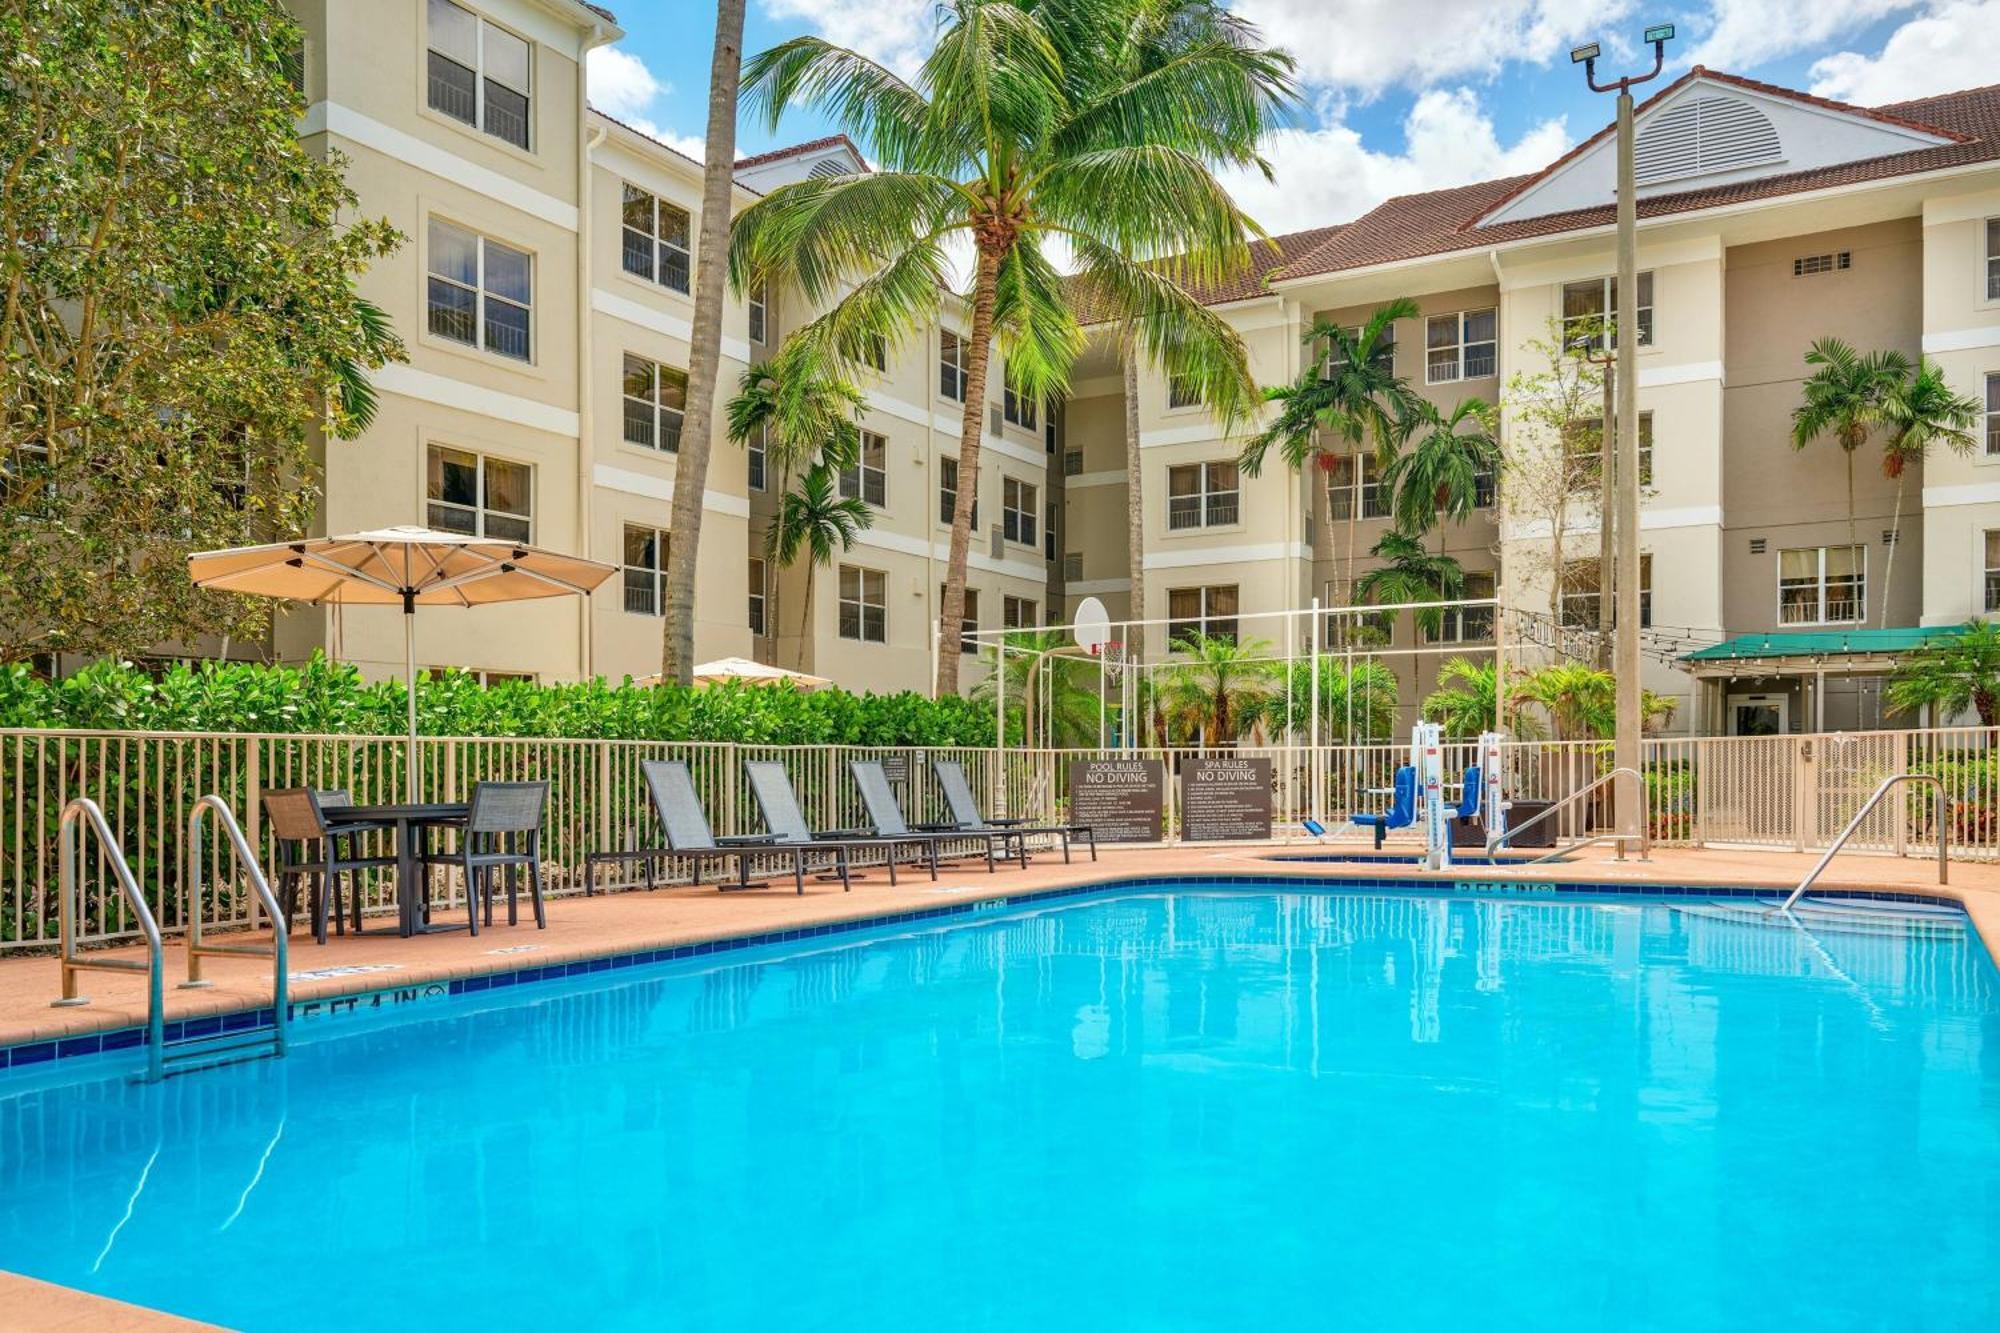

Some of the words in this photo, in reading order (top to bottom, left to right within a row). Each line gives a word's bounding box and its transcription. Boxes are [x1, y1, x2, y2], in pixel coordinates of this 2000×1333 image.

[1090, 762, 1113, 771] POOL
[1116, 762, 1144, 770] RULES
[1204, 761, 1221, 769] SPA
[1222, 760, 1249, 769] RULES
[1086, 773, 1105, 784] NO
[1107, 772, 1148, 784] DIVING
[1196, 771, 1215, 781] NO
[1217, 771, 1256, 781] DIVING
